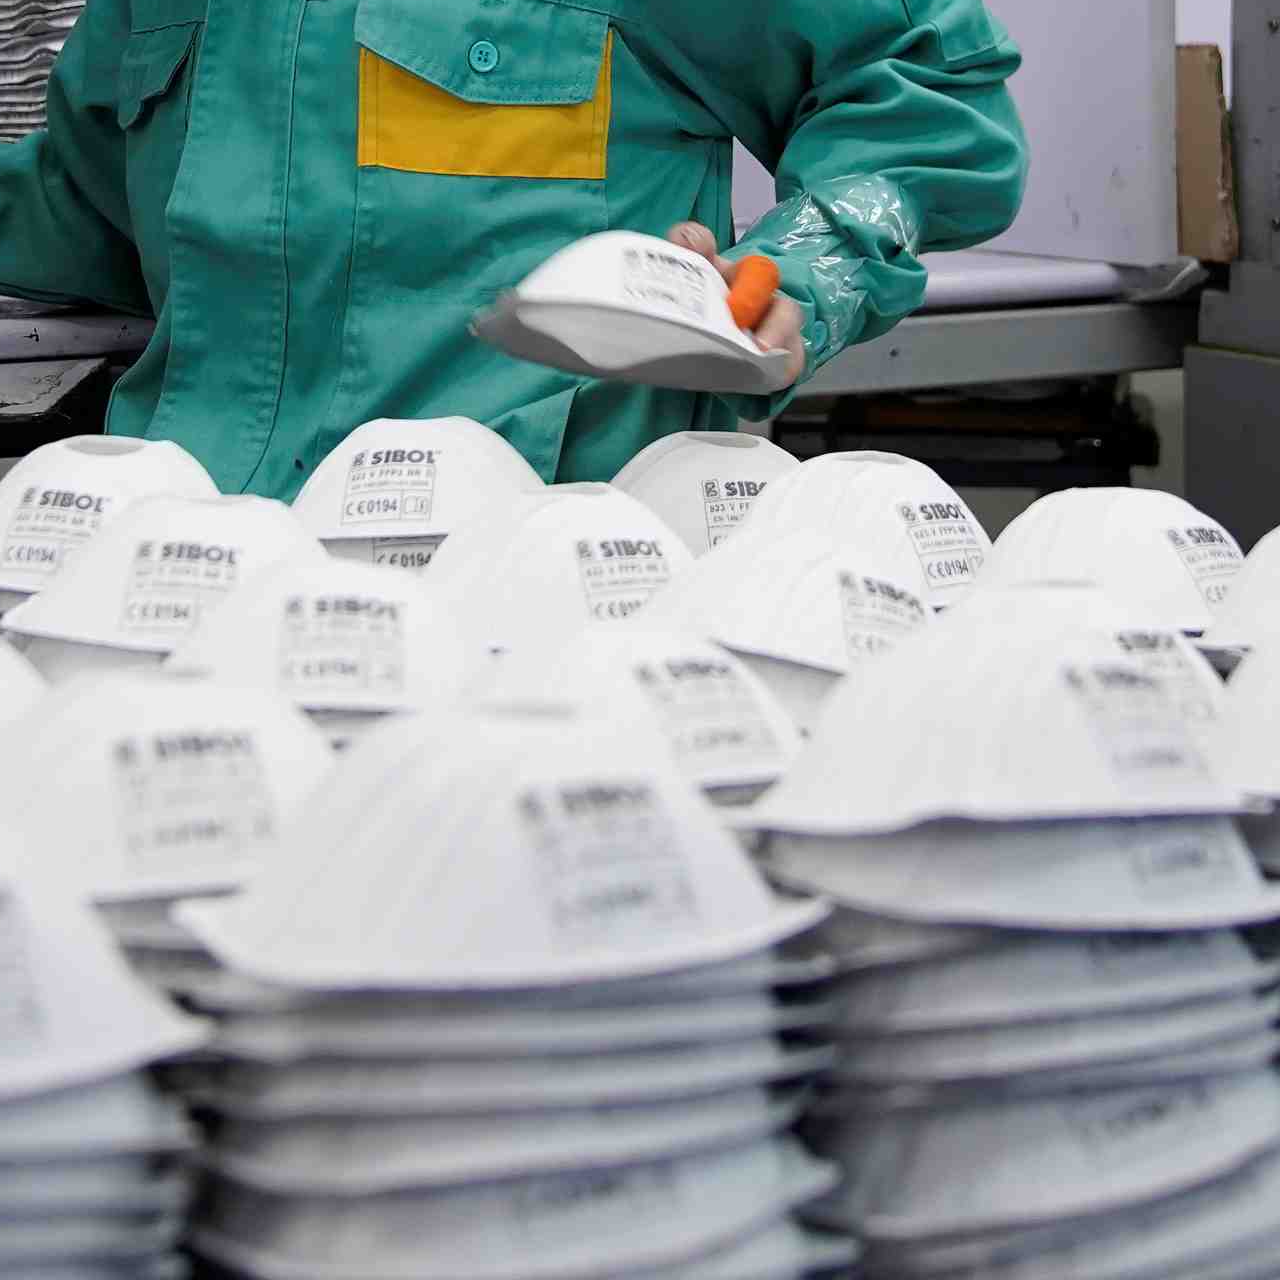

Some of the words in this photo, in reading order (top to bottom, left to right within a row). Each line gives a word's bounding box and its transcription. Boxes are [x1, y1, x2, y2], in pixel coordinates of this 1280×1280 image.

[371, 449, 434, 465] SIBOL
[39, 489, 105, 513] SIBOL
[600, 539, 663, 558] SIBOL
